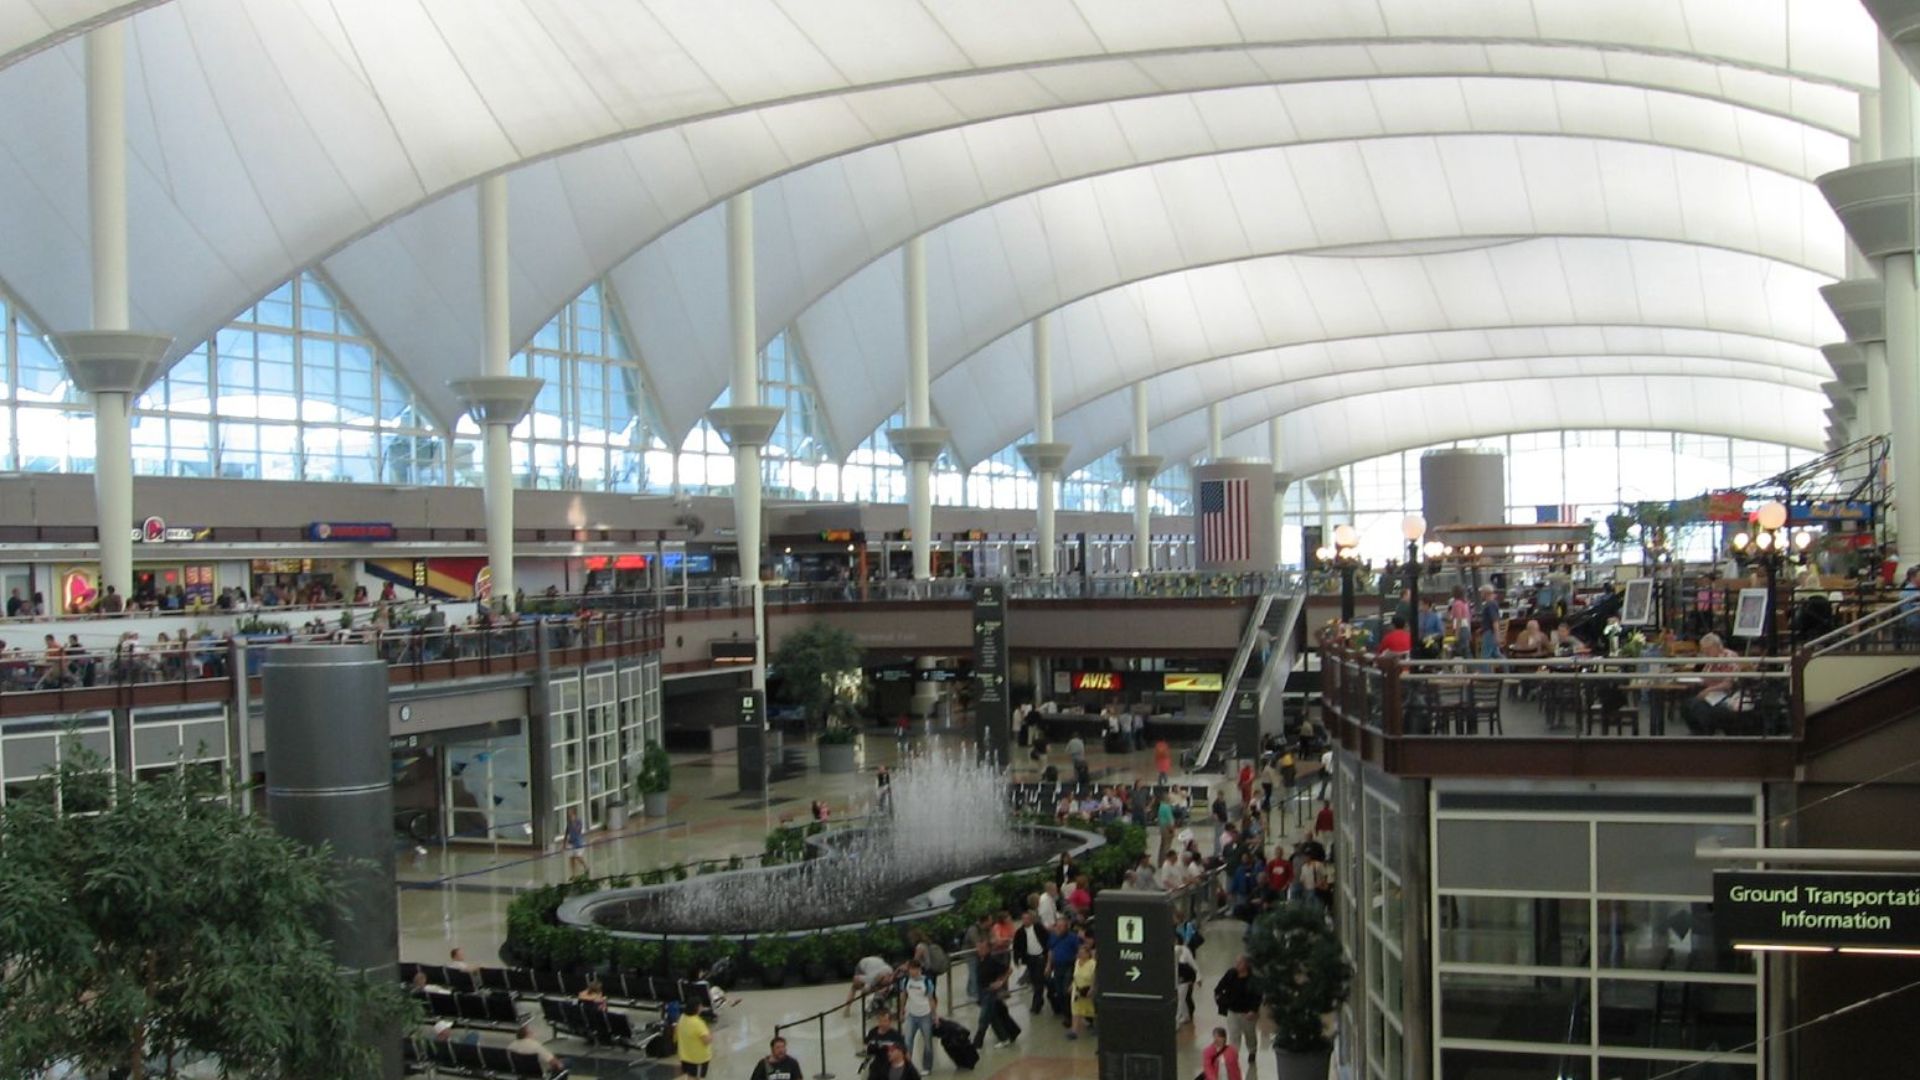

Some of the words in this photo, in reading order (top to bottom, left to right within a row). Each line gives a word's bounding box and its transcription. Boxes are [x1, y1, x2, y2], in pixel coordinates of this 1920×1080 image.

[1079, 673, 1112, 689] AVIS
[1729, 885, 1798, 903] Ground
[1805, 887, 1920, 908] Transportati
[1781, 910, 1891, 929] Information
[1120, 949, 1143, 961] Men
